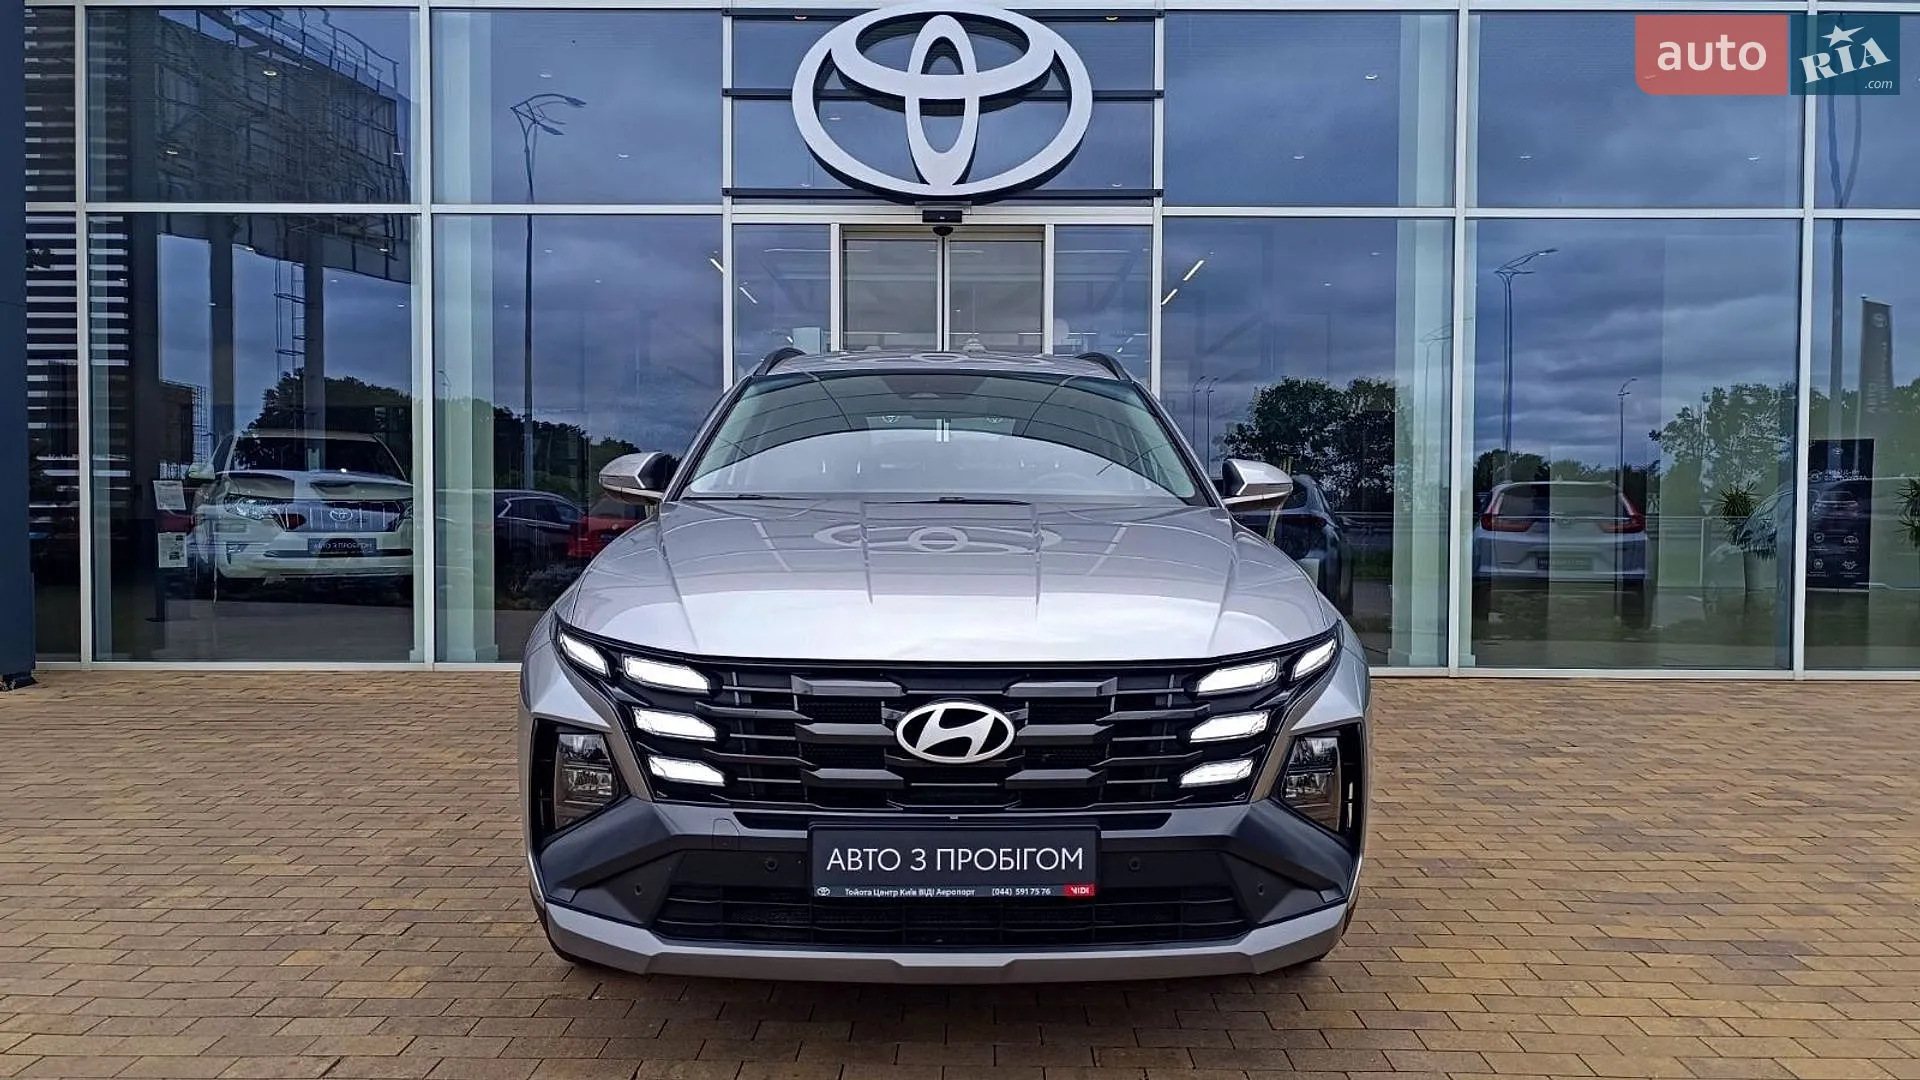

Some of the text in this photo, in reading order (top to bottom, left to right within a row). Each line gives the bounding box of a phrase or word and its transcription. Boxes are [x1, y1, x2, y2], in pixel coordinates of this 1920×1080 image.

[826, 847, 1083, 871] АВТО З ПРОБІГОМ
[844, 888, 873, 897] Тойота
[873, 888, 899, 898] Центр
[899, 887, 917, 897] Київ
[936, 888, 976, 898] Аеропорт
[992, 887, 1013, 897] (044)
